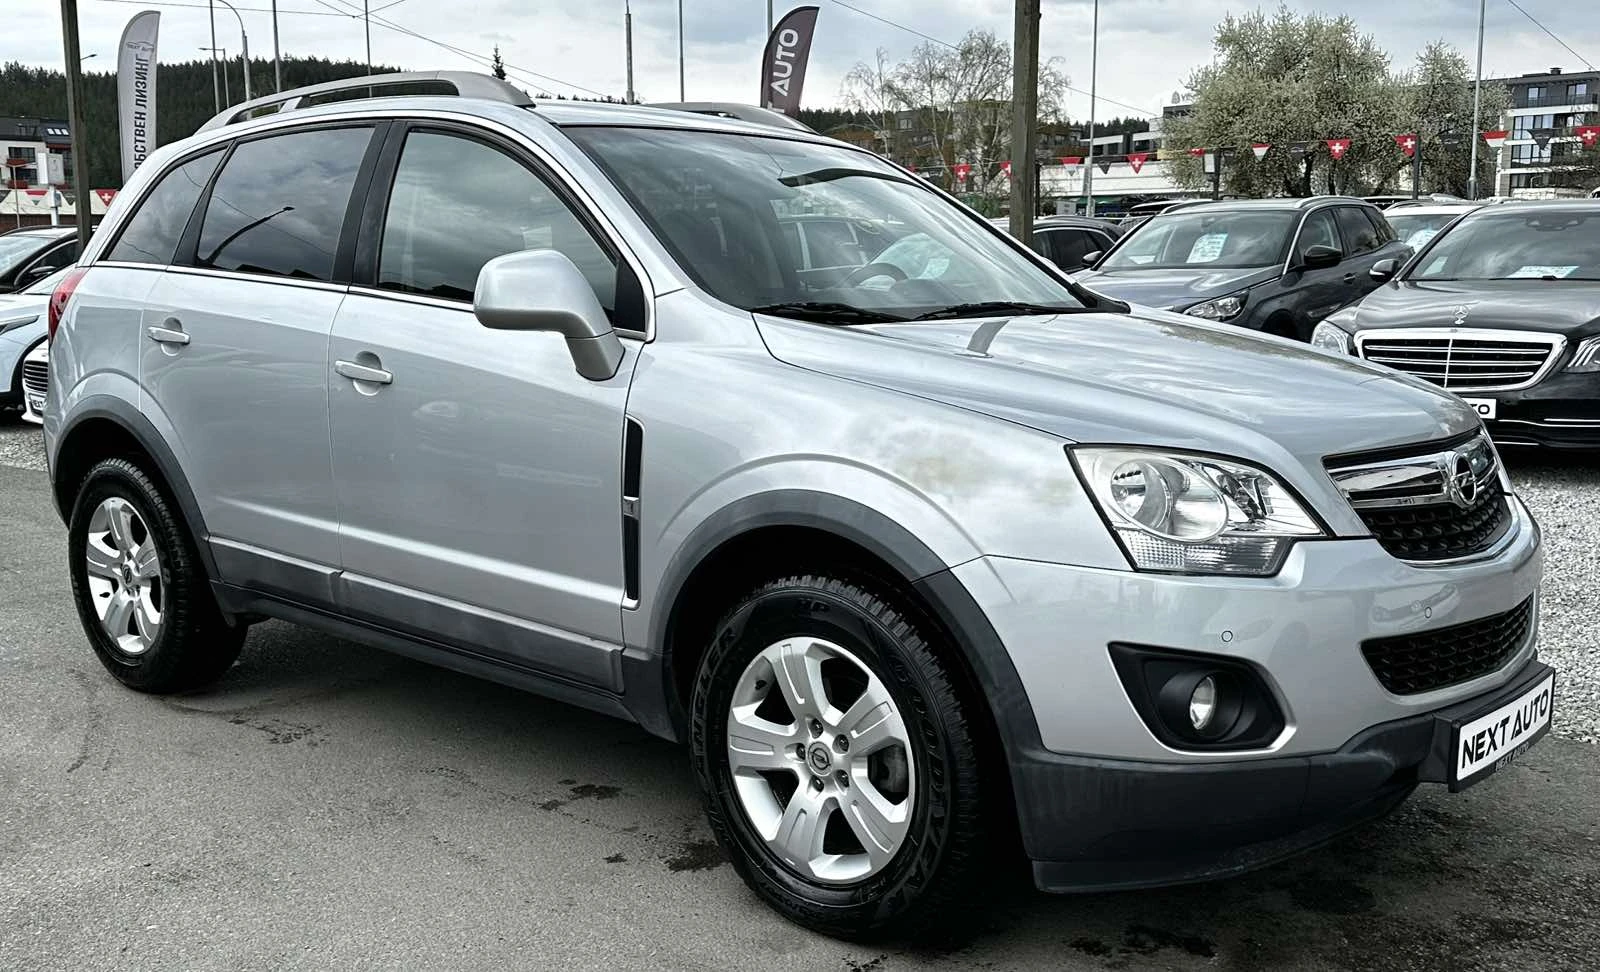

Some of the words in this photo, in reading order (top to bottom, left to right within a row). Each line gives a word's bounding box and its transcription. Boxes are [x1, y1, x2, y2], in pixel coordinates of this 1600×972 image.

[135, 54, 149, 109] ЛИЗИНГ
[770, 28, 799, 97] AUTO
[1462, 715, 1511, 769] NEXT
[1511, 689, 1549, 741] AUTO
